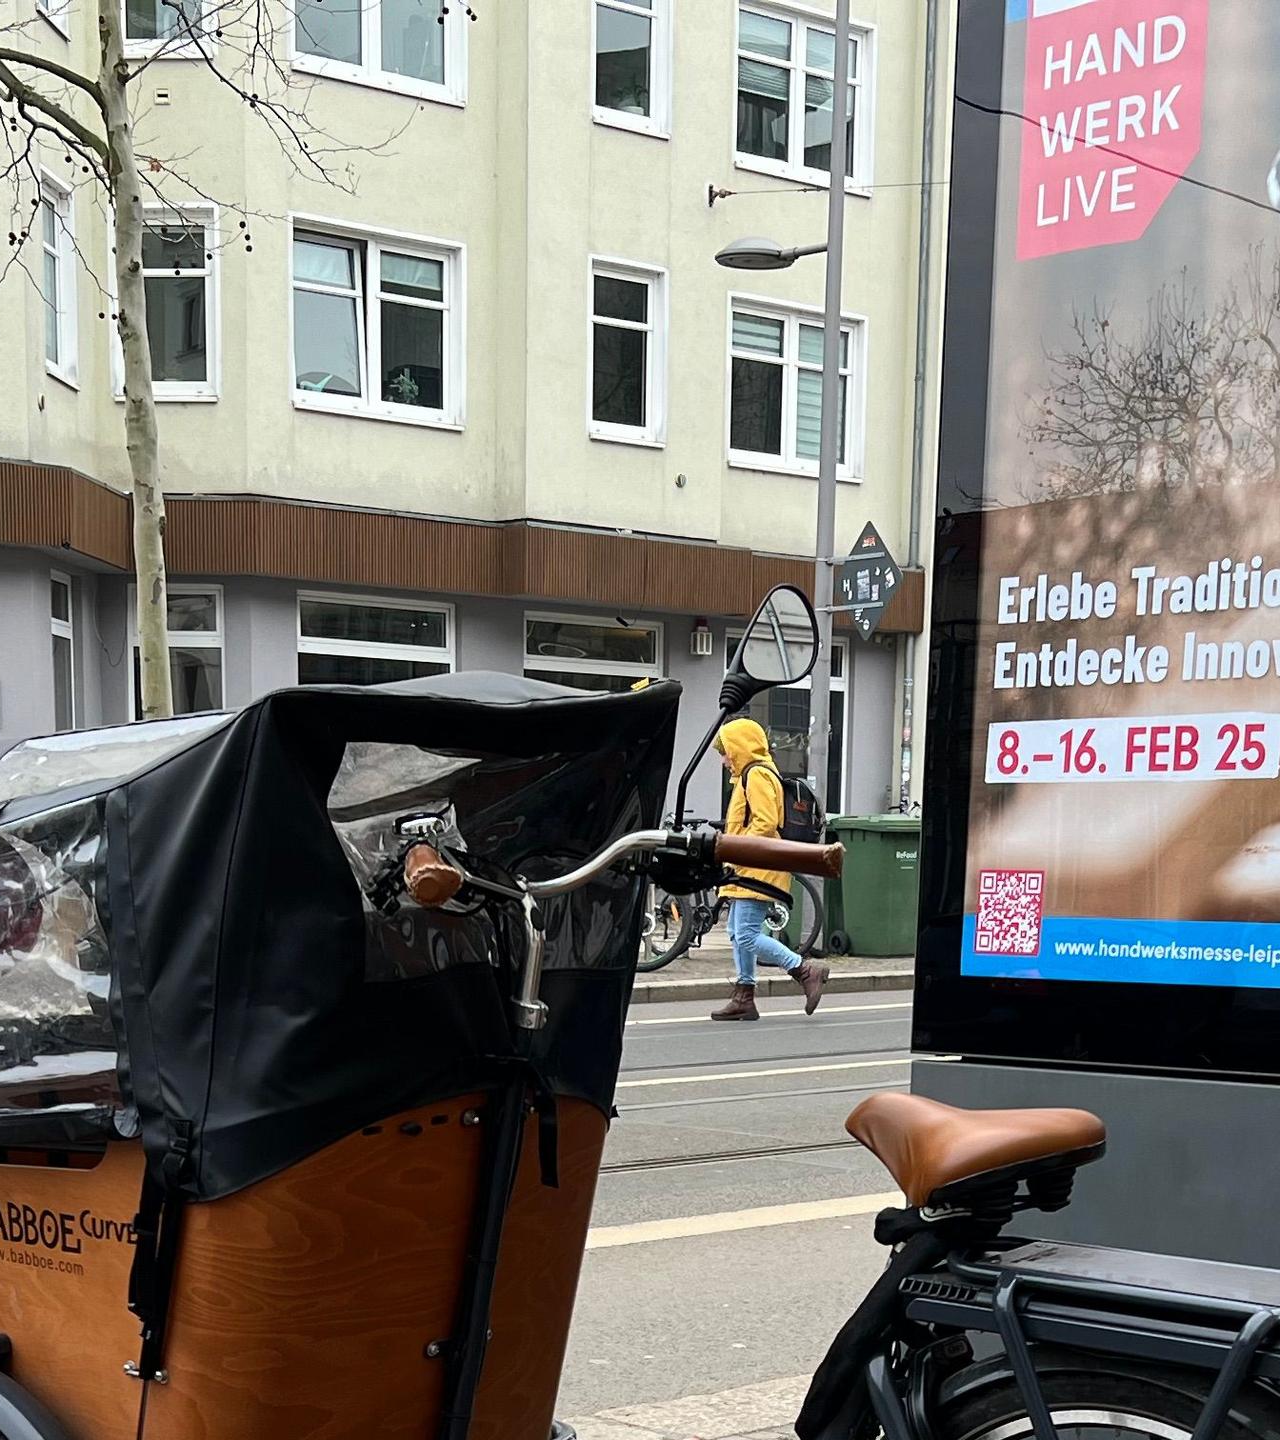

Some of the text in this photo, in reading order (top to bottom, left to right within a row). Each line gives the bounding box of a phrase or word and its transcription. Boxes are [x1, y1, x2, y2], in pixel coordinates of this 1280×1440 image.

[1043, 15, 1186, 90] HAND
[1039, 84, 1182, 158] WERK
[1036, 165, 1137, 227] LIVE
[997, 571, 1117, 625] Erlebe
[993, 634, 1169, 690] Entdecke
[1124, 724, 1200, 773] FEB
[1214, 722, 1267, 772] 25
